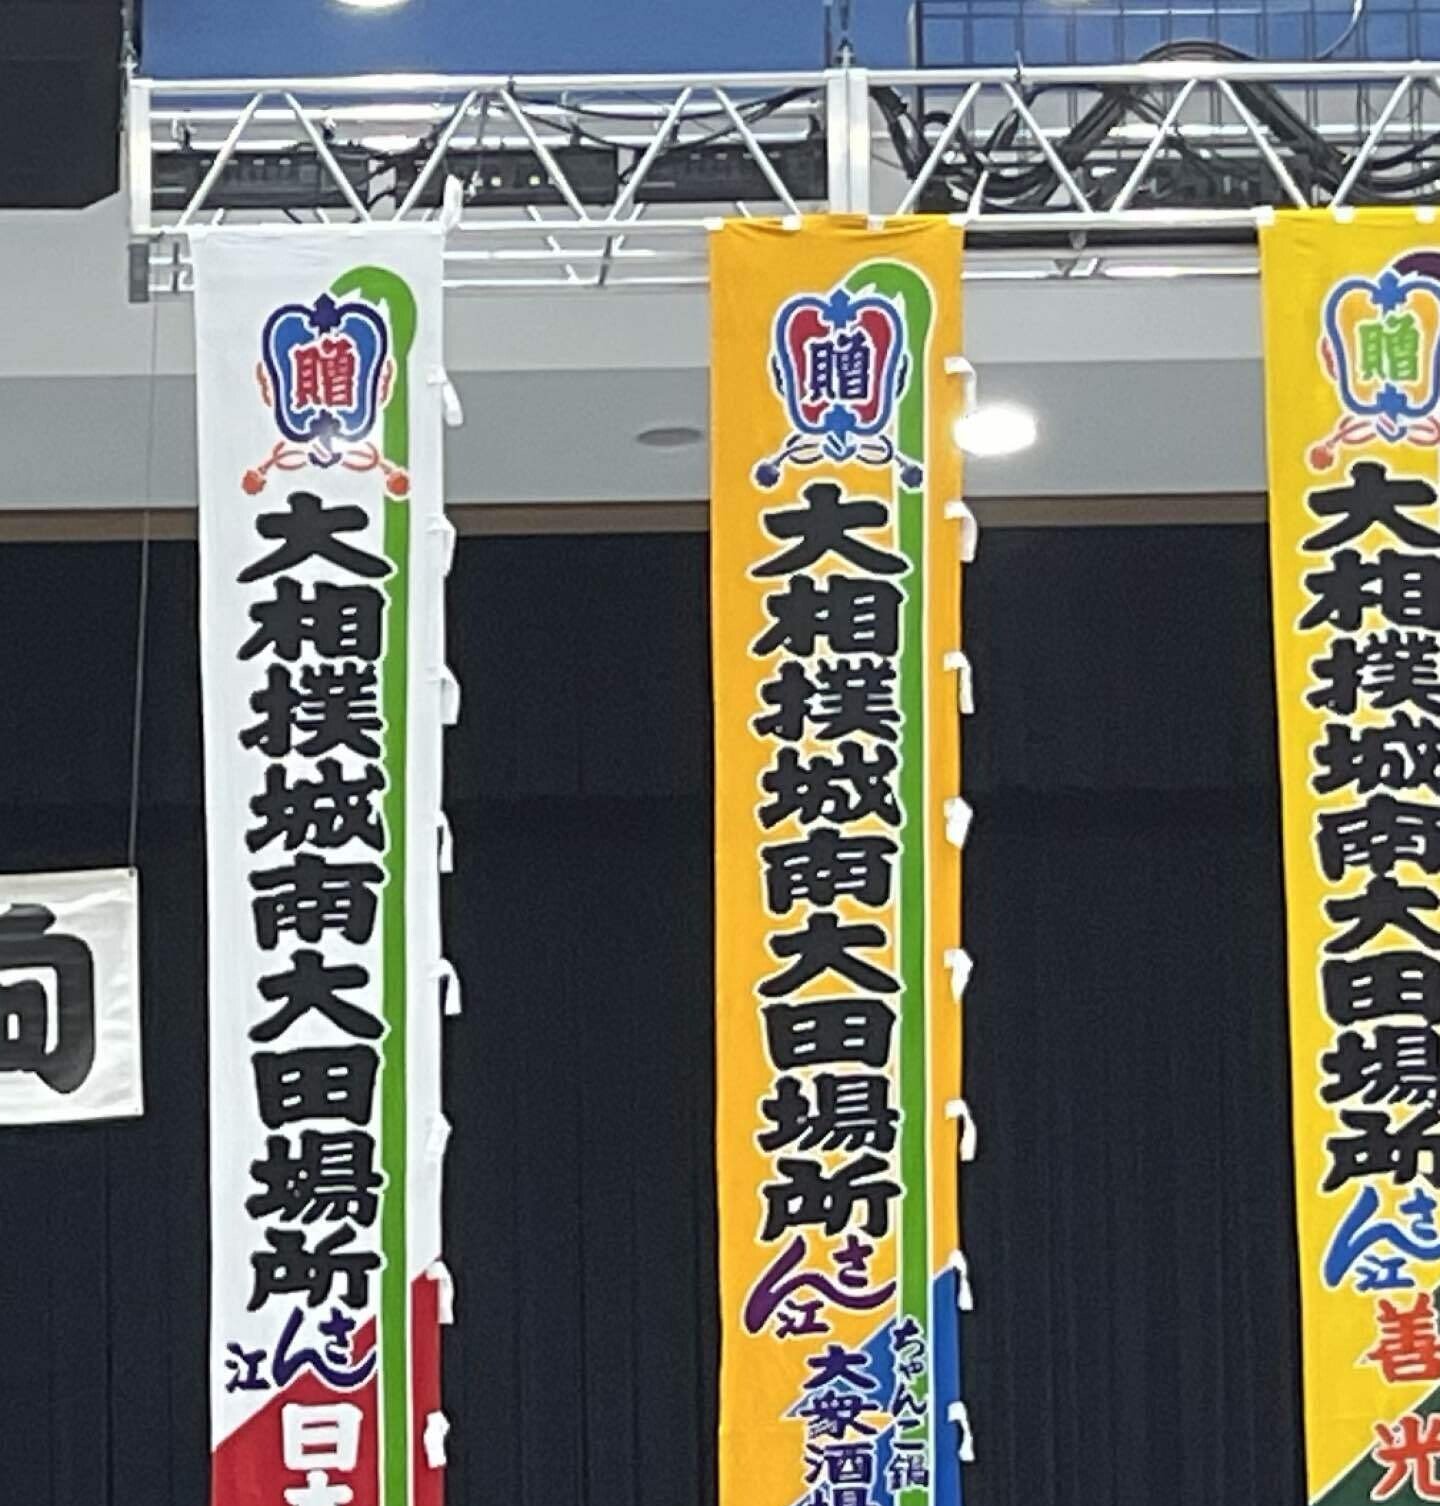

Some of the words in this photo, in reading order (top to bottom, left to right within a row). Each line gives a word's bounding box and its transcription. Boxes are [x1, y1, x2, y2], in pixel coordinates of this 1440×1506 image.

[293, 343, 358, 412] 贈
[808, 337, 874, 403] 贈
[1357, 318, 1421, 386] 贈
[238, 493, 394, 1314] 大相撲城南大田場所
[752, 483, 908, 1243] 大相撲城南大田場所
[887, 1316, 930, 1490] ちゃんこ鍋
